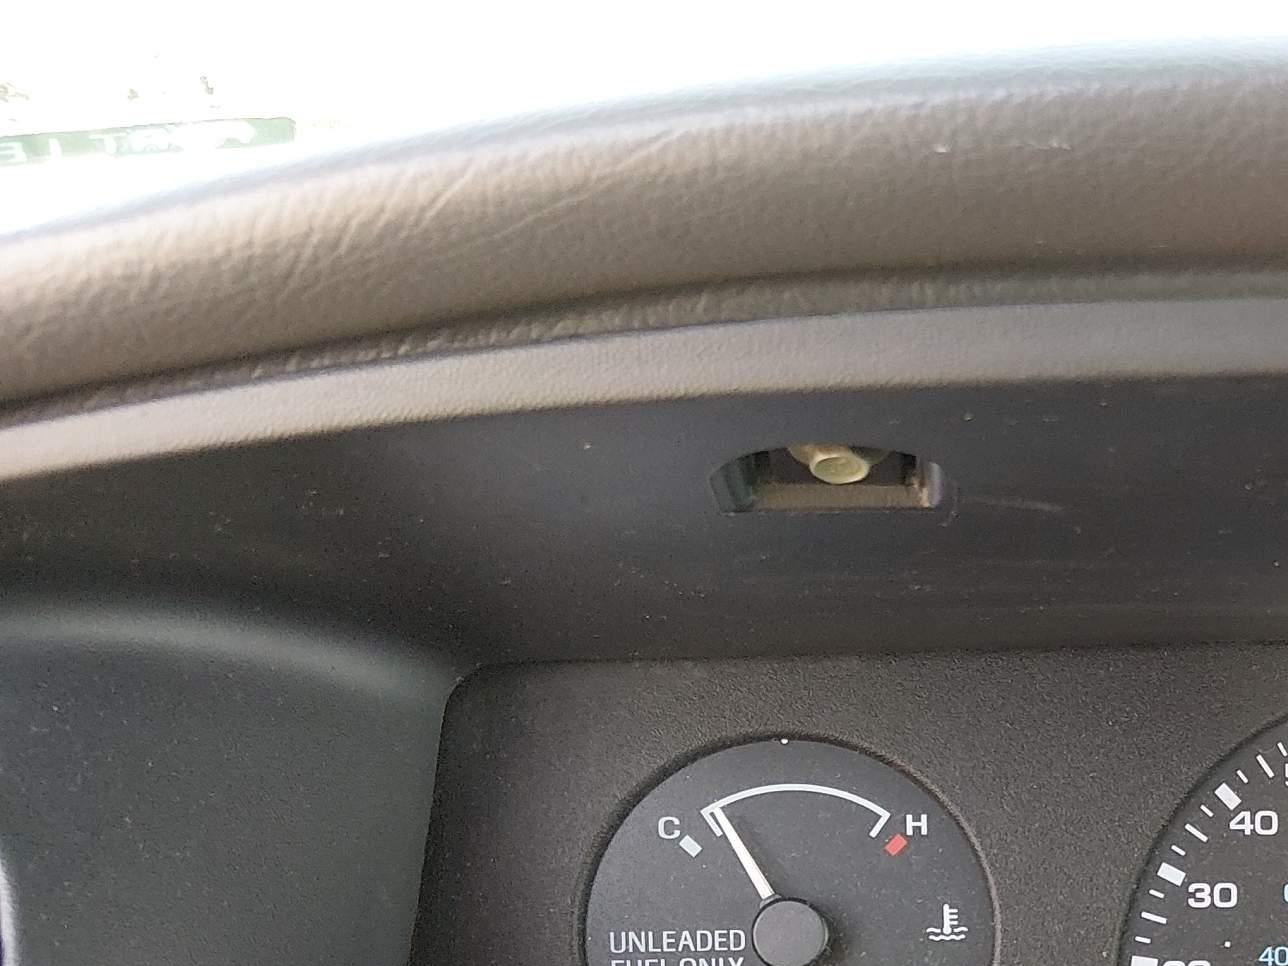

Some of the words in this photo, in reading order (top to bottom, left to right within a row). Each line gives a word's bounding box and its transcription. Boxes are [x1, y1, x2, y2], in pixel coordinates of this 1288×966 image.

[657, 815, 681, 839] C
[906, 814, 928, 835] H
[1229, 810, 1279, 836] 40
[1187, 882, 1238, 908] 30
[609, 928, 746, 953] UNLEADED
